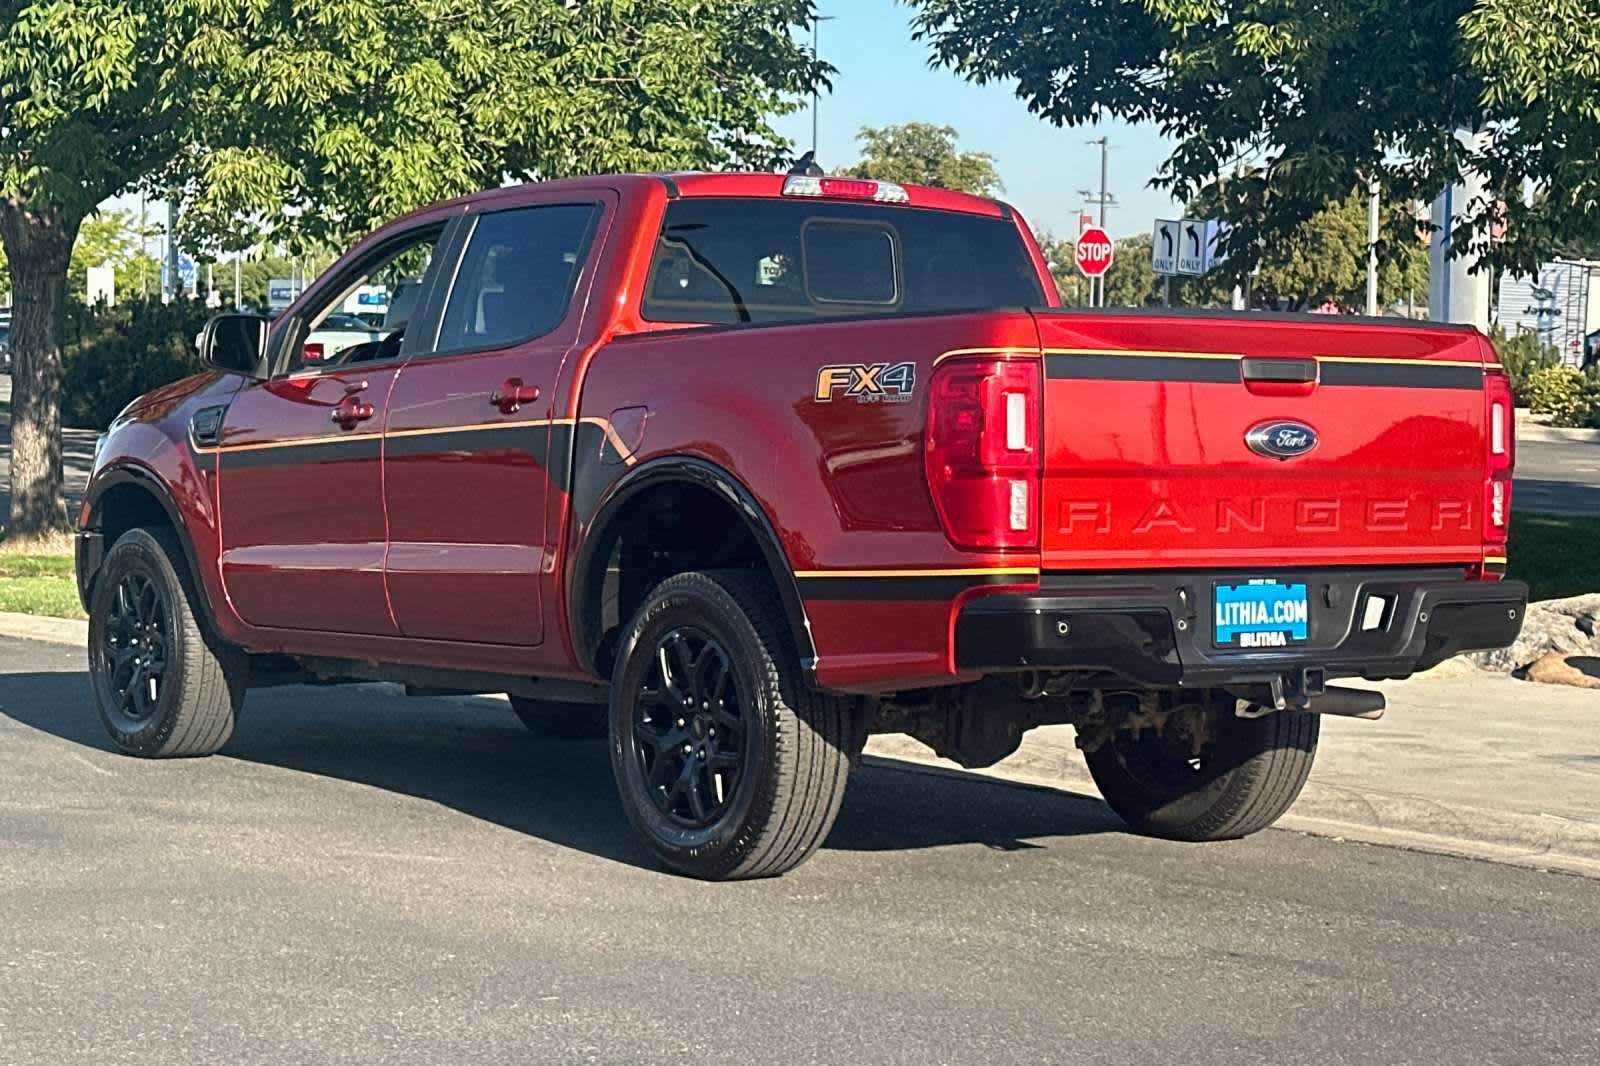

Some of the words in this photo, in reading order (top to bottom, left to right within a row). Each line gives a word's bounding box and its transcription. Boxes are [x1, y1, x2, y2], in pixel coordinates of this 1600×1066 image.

[1078, 242, 1111, 262] STOP
[1154, 258, 1174, 271] ONLY
[1180, 258, 1201, 271] ONLY
[1523, 305, 1562, 317] Jayco
[815, 361, 916, 402] FX4
[1276, 429, 1307, 448] Ford
[1059, 499, 1472, 534] RANGER
[1216, 599, 1308, 626] LITHIA.COM
[1250, 631, 1287, 647] LITHIA
